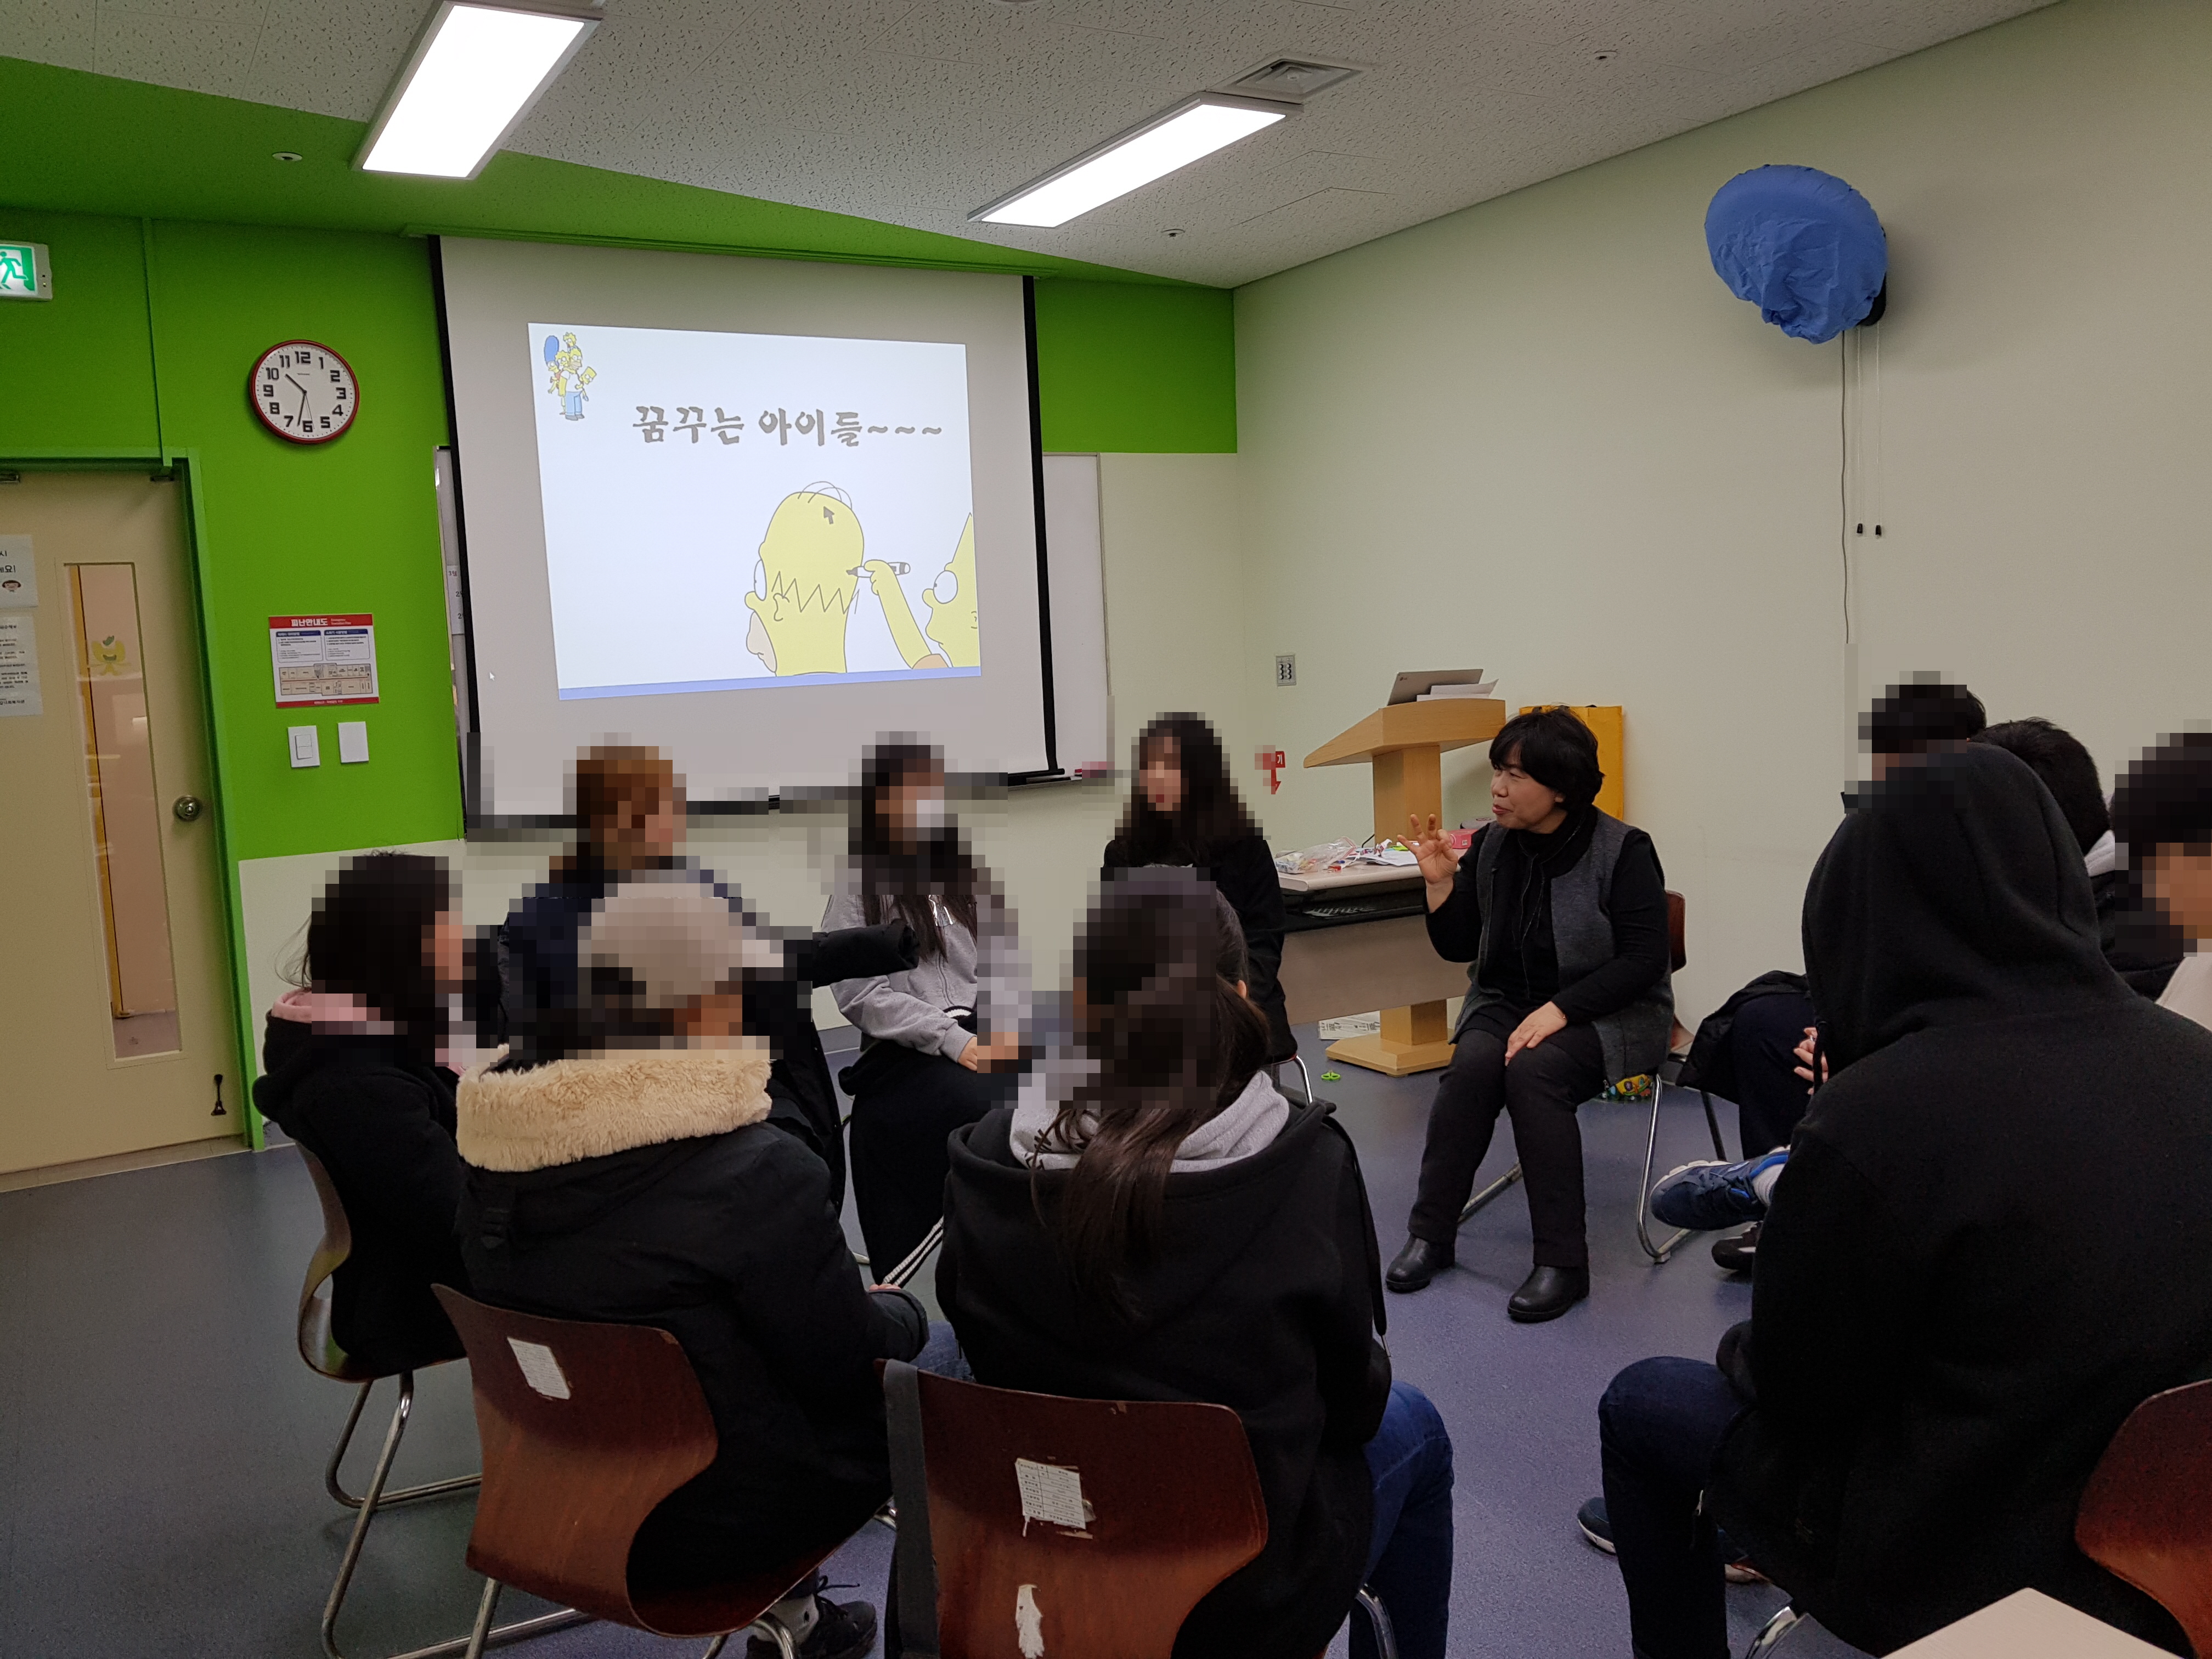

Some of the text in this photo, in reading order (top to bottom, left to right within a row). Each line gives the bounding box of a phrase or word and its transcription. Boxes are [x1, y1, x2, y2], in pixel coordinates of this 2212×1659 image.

[279, 355, 290, 368] 11
[295, 351, 311, 364] 12
[319, 357, 324, 369] 1
[266, 367, 279, 380] 10
[330, 370, 340, 382] 2
[263, 384, 274, 397] 9
[336, 387, 346, 399] 3
[269, 402, 280, 414] 8
[332, 404, 343, 416] 4
[284, 415, 294, 427] 7
[302, 420, 313, 432] 6
[320, 416, 330, 428] 5
[632, 405, 745, 445] 꿈꾸는
[291, 618, 329, 627] 피난안내도
